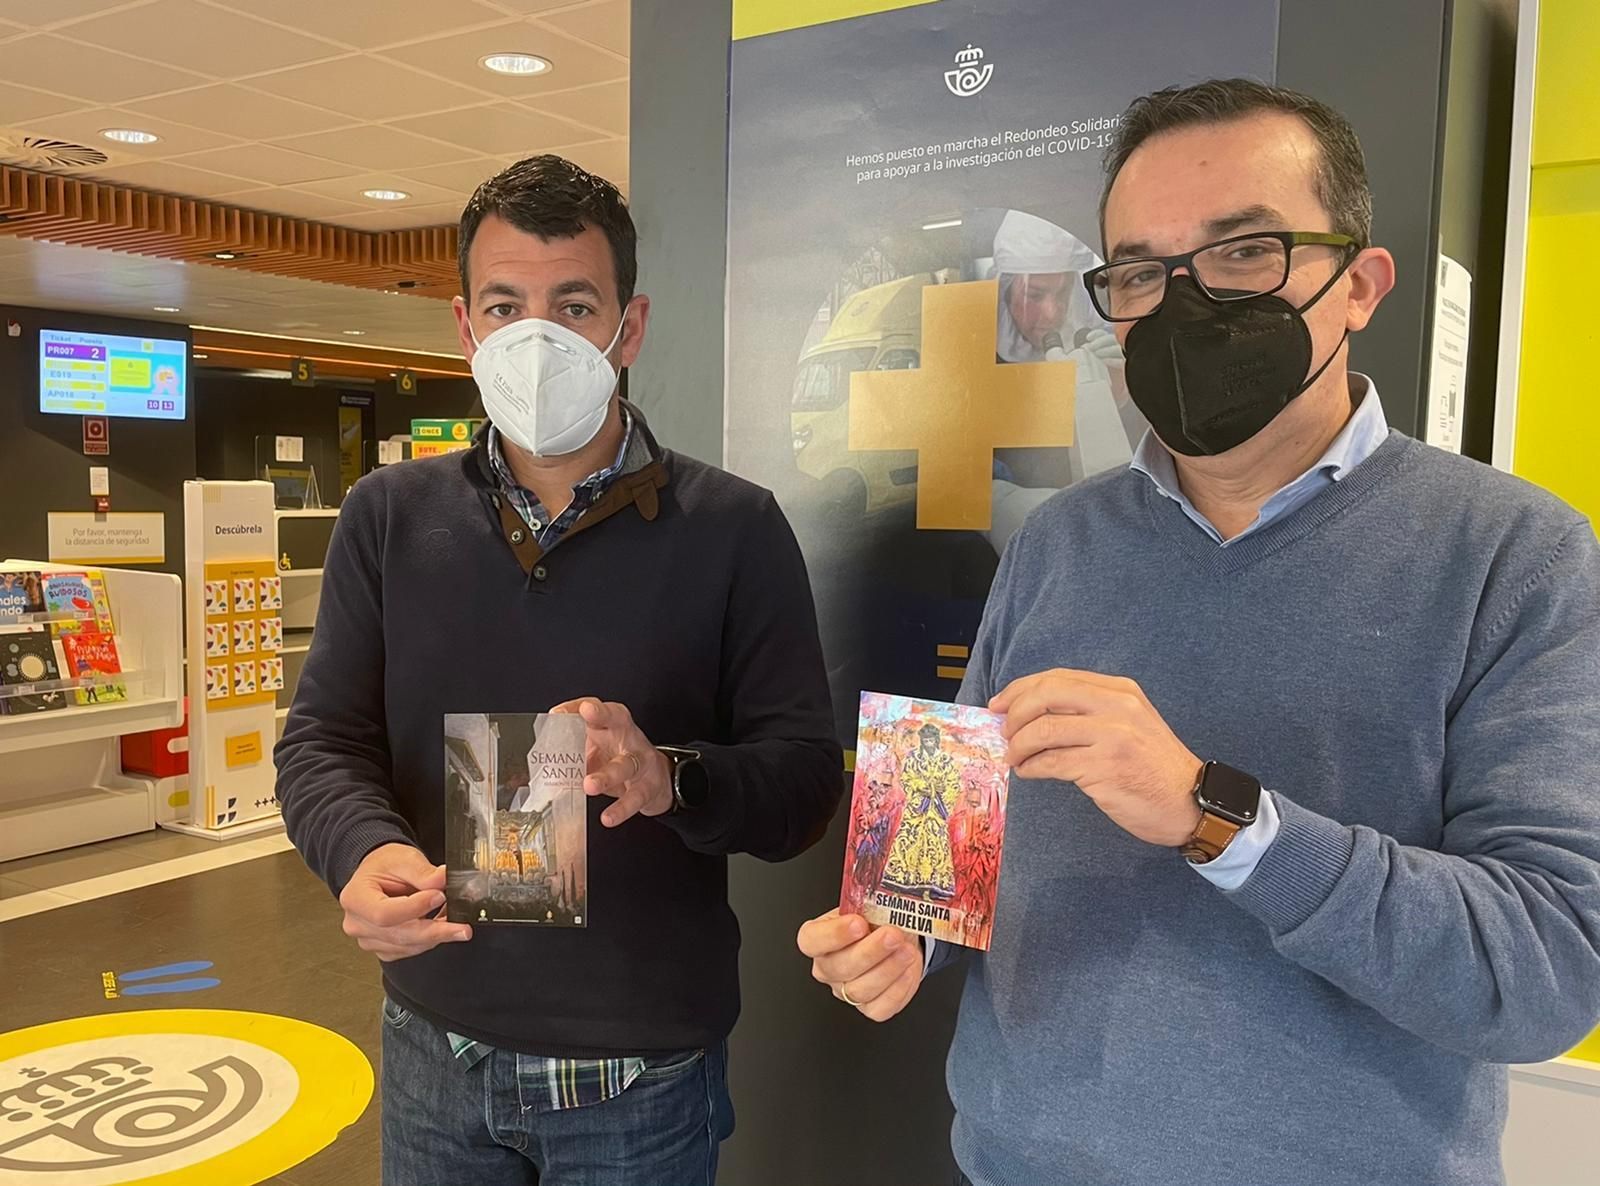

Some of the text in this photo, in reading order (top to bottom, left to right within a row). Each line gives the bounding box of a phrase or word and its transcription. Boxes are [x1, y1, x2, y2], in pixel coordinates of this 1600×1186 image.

[846, 153, 884, 167] Hemos
[886, 147, 925, 164] puesto
[927, 144, 941, 155] en
[944, 136, 988, 153] marcha
[991, 133, 1001, 145] el
[1004, 125, 1068, 144] Redondeo
[857, 133, 1114, 184] para apoyar a la investigación del COVID-19
[47, 345, 100, 359] PR007 2
[298, 363, 308, 381] 5
[401, 374, 412, 390] 6
[72, 528, 142, 538] Por favor, mantenga
[215, 524, 263, 535] Descúbrela
[73, 537, 104, 545] distancia
[106, 537, 115, 545] de
[116, 537, 150, 546] seguridad
[530, 751, 584, 764] SEMANA
[542, 765, 585, 779] SANTA
[876, 893, 950, 921] SEMANA SANTA
[889, 910, 933, 933] HUELVA
